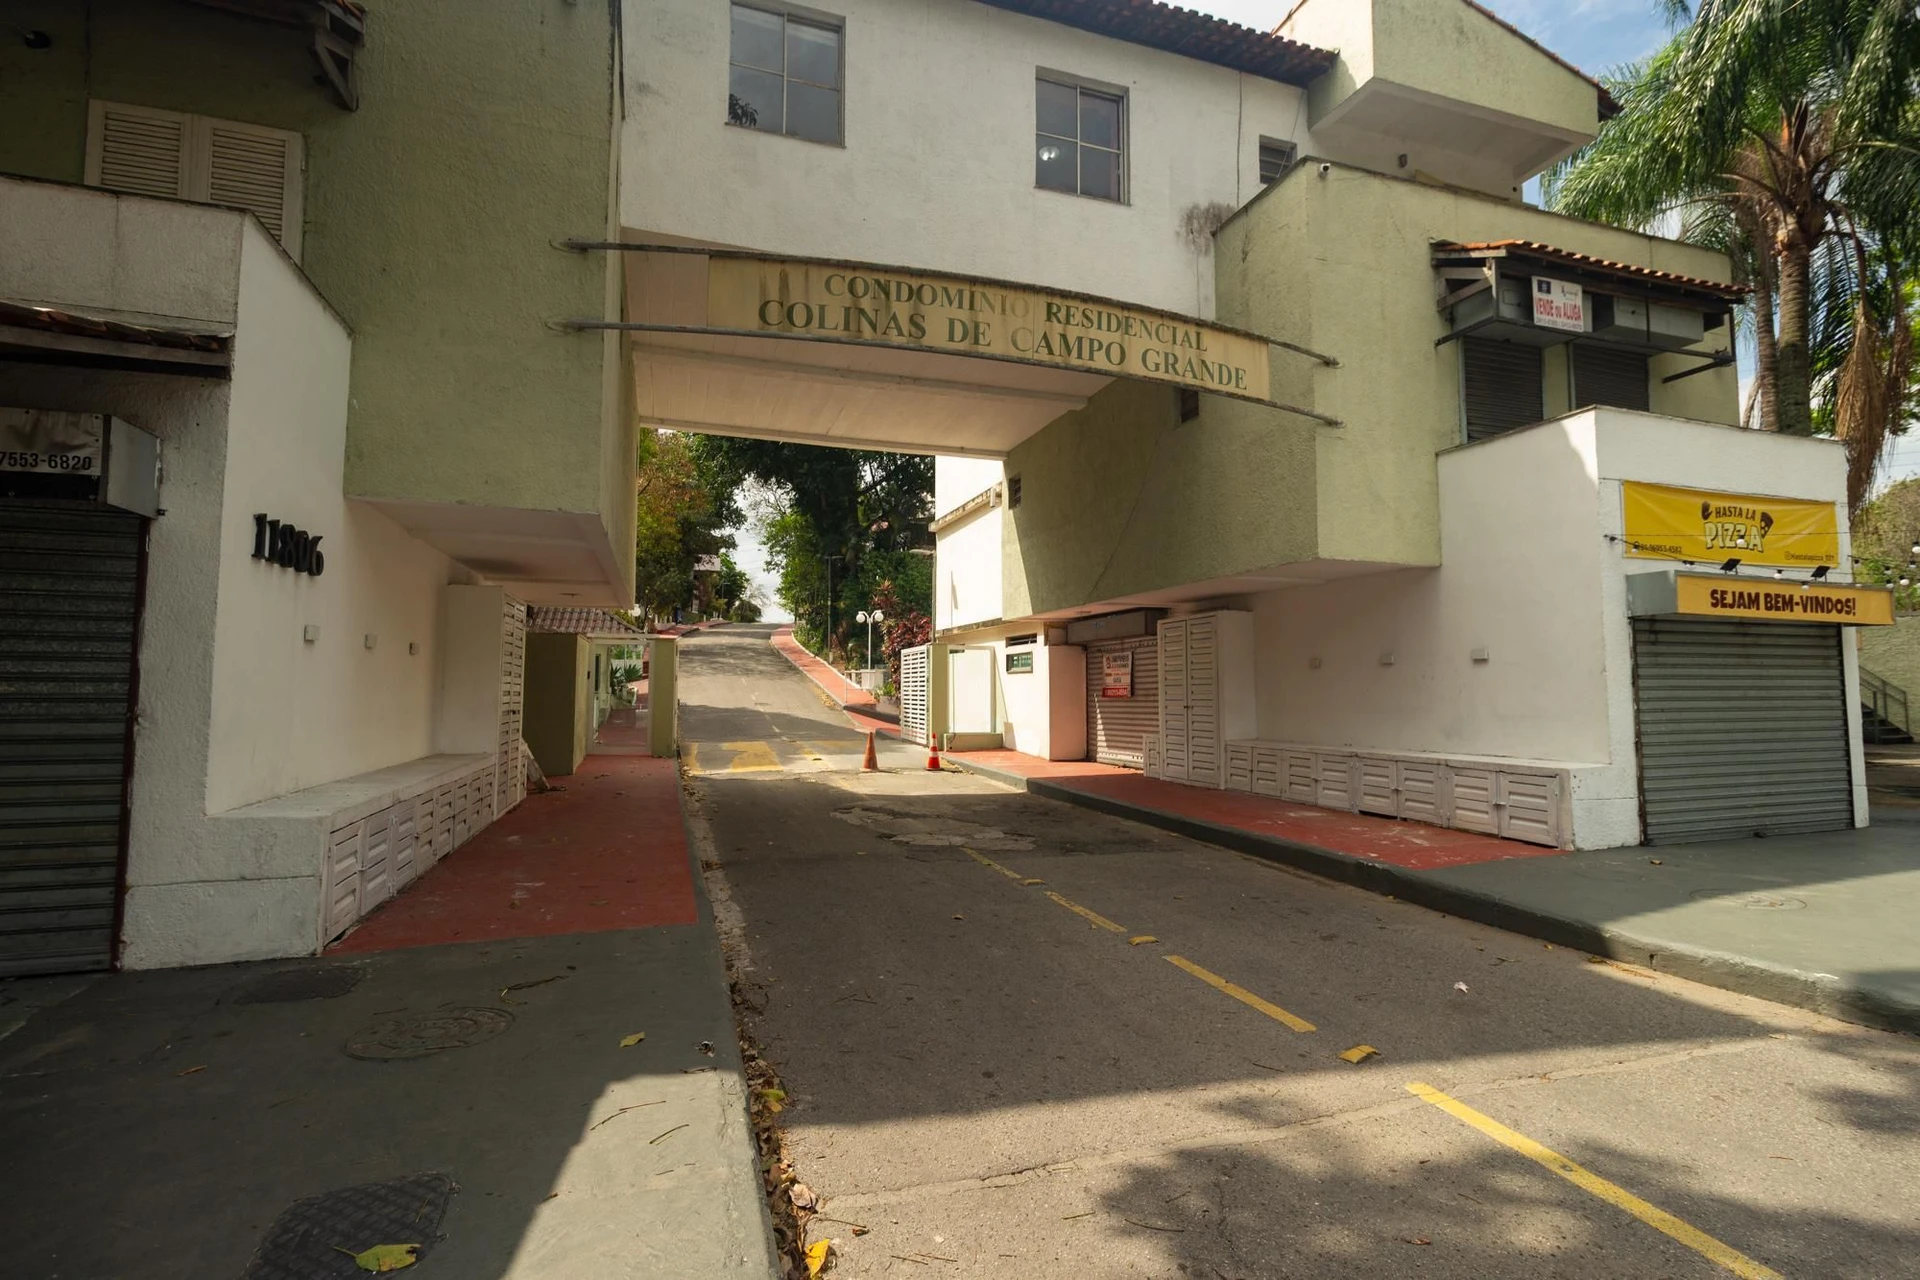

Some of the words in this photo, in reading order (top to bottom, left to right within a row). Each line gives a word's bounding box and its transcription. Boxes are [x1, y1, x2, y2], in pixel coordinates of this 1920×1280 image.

[1535, 297, 1554, 317] VENDE
[1563, 302, 1582, 321] ALUGA
[1044, 301, 1208, 352] RESIDENCIAL
[758, 300, 927, 339] COLINAS
[947, 317, 992, 347] DE
[1011, 326, 1127, 366] CAMPO
[1141, 348, 1248, 391] GRANDE
[1715, 505, 1743, 518] HASTA
[1745, 508, 1756, 521] LA
[251, 513, 324, 576] 11806
[1704, 521, 1764, 553] PIZZA
[1710, 589, 1760, 611] SEJAM
[1764, 592, 1856, 616] BEM-VINDOS!
